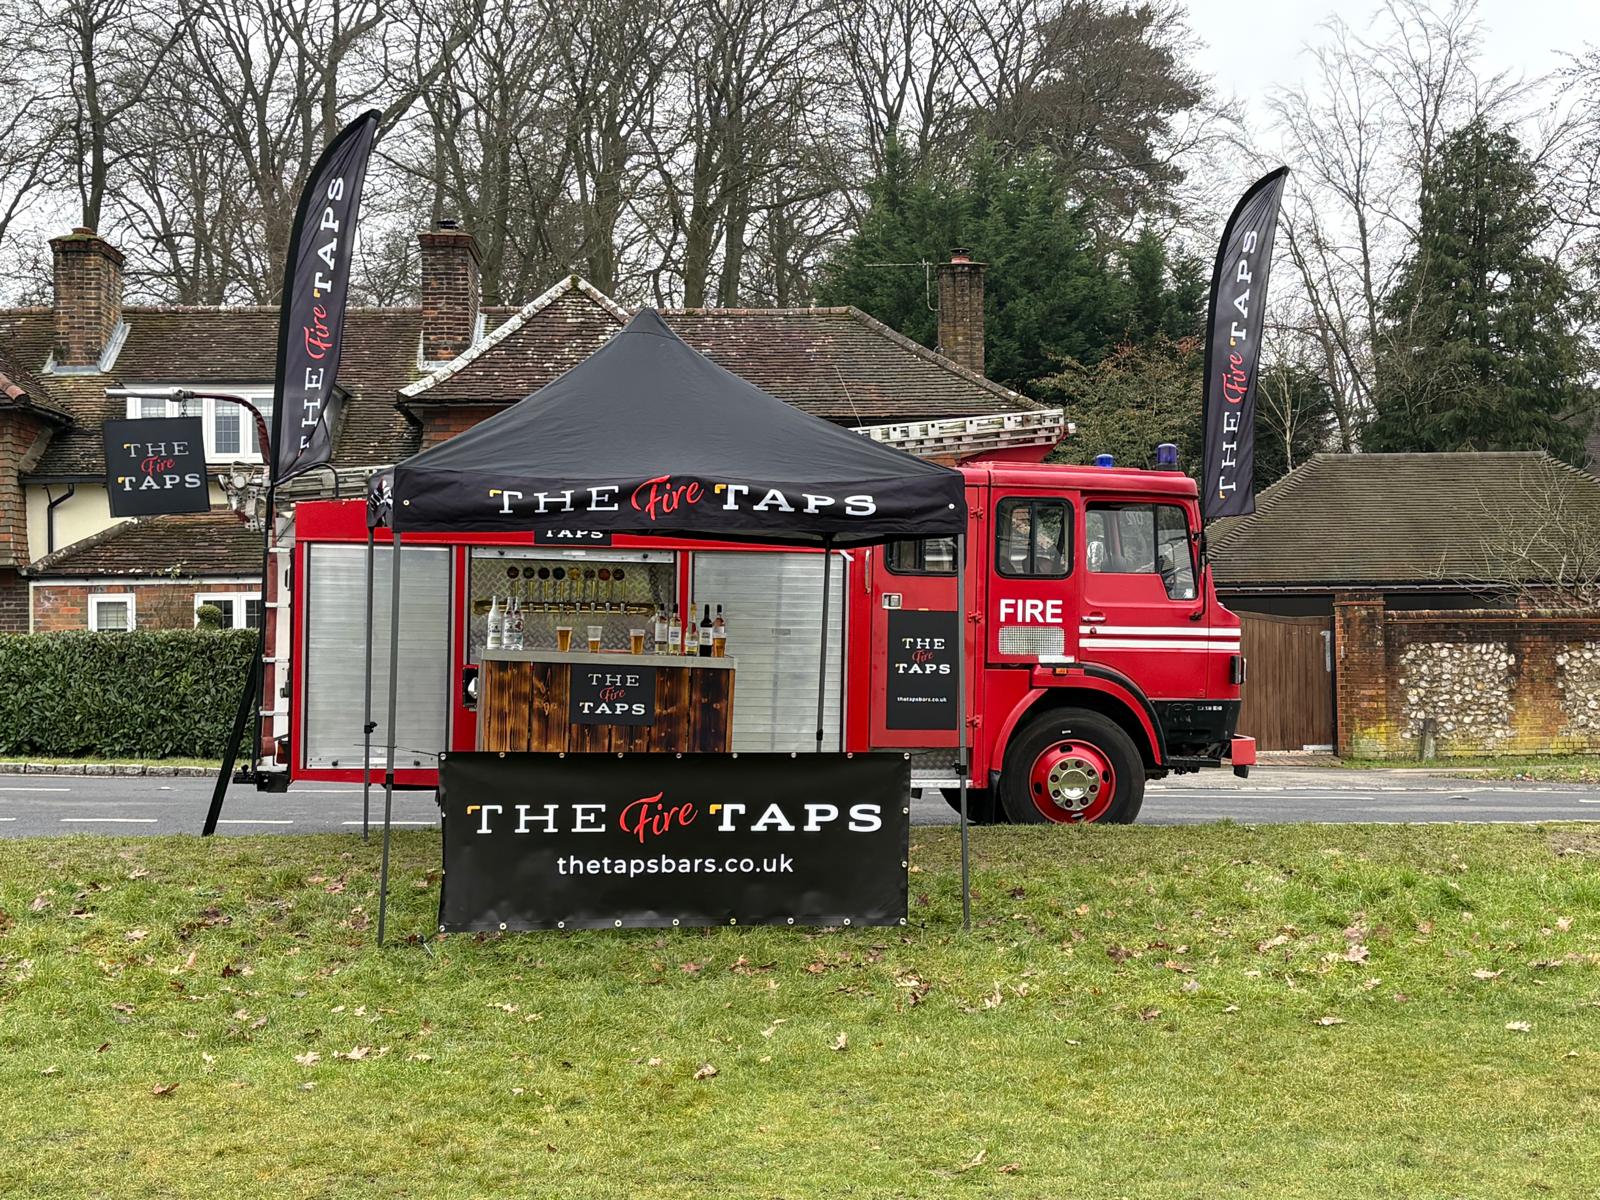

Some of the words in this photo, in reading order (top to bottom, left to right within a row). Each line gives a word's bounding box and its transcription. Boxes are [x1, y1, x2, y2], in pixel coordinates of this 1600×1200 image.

[313, 176, 345, 299] TAPS
[1230, 230, 1258, 347] TAPS
[303, 303, 333, 360] Fire
[1222, 351, 1248, 404] Fire
[123, 441, 190, 458] THE
[1219, 411, 1242, 500] THE
[140, 456, 176, 477] Fire
[117, 473, 202, 492] TAPS
[489, 485, 619, 514] THE
[630, 474, 705, 521] Fire
[713, 483, 878, 517] TAPS
[999, 598, 1064, 623] FIRE
[901, 638, 946, 650] THE
[911, 648, 935, 664] Fire
[587, 673, 640, 687] THE
[895, 663, 951, 675] TAPS
[599, 685, 626, 703] Fire
[579, 702, 646, 716] TAPS
[467, 803, 607, 834] THE
[618, 791, 699, 844] Fire
[709, 803, 882, 833] TAPS
[556, 853, 794, 879] thetapsbars.co.uk
